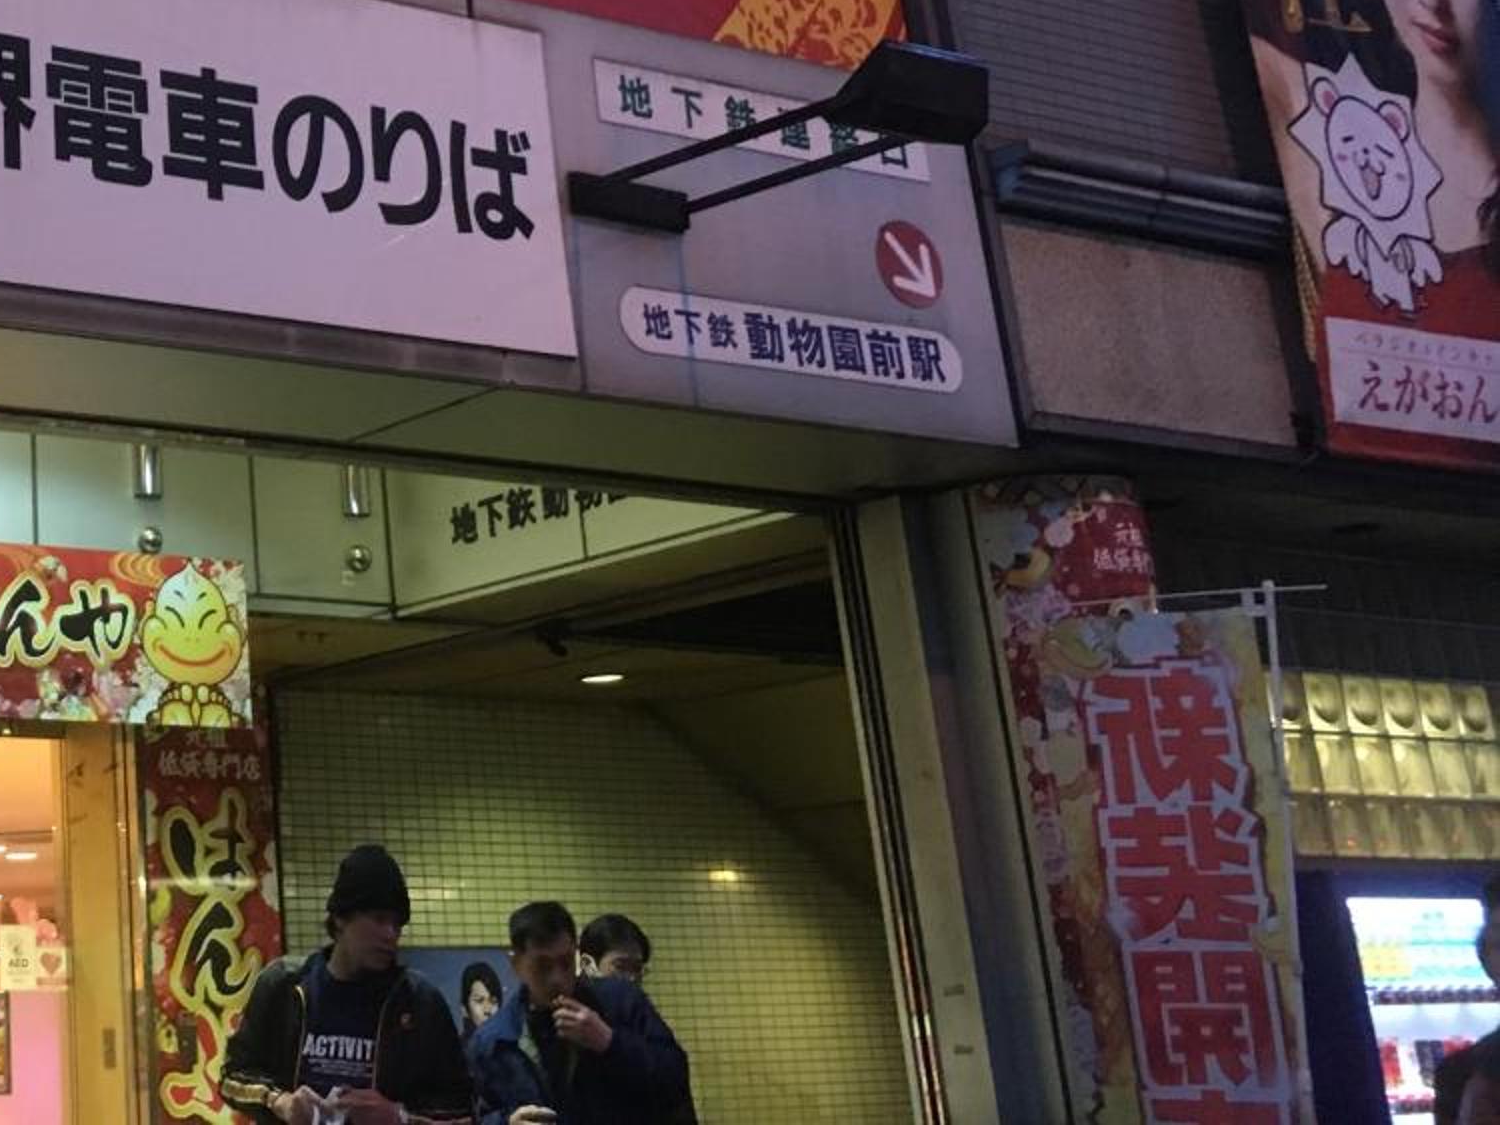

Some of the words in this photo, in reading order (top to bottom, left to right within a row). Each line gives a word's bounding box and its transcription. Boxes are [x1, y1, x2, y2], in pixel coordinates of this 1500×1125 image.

[643, 303, 947, 383] 地下鉄動物園前駅
[1357, 358, 1499, 424] えがおん
